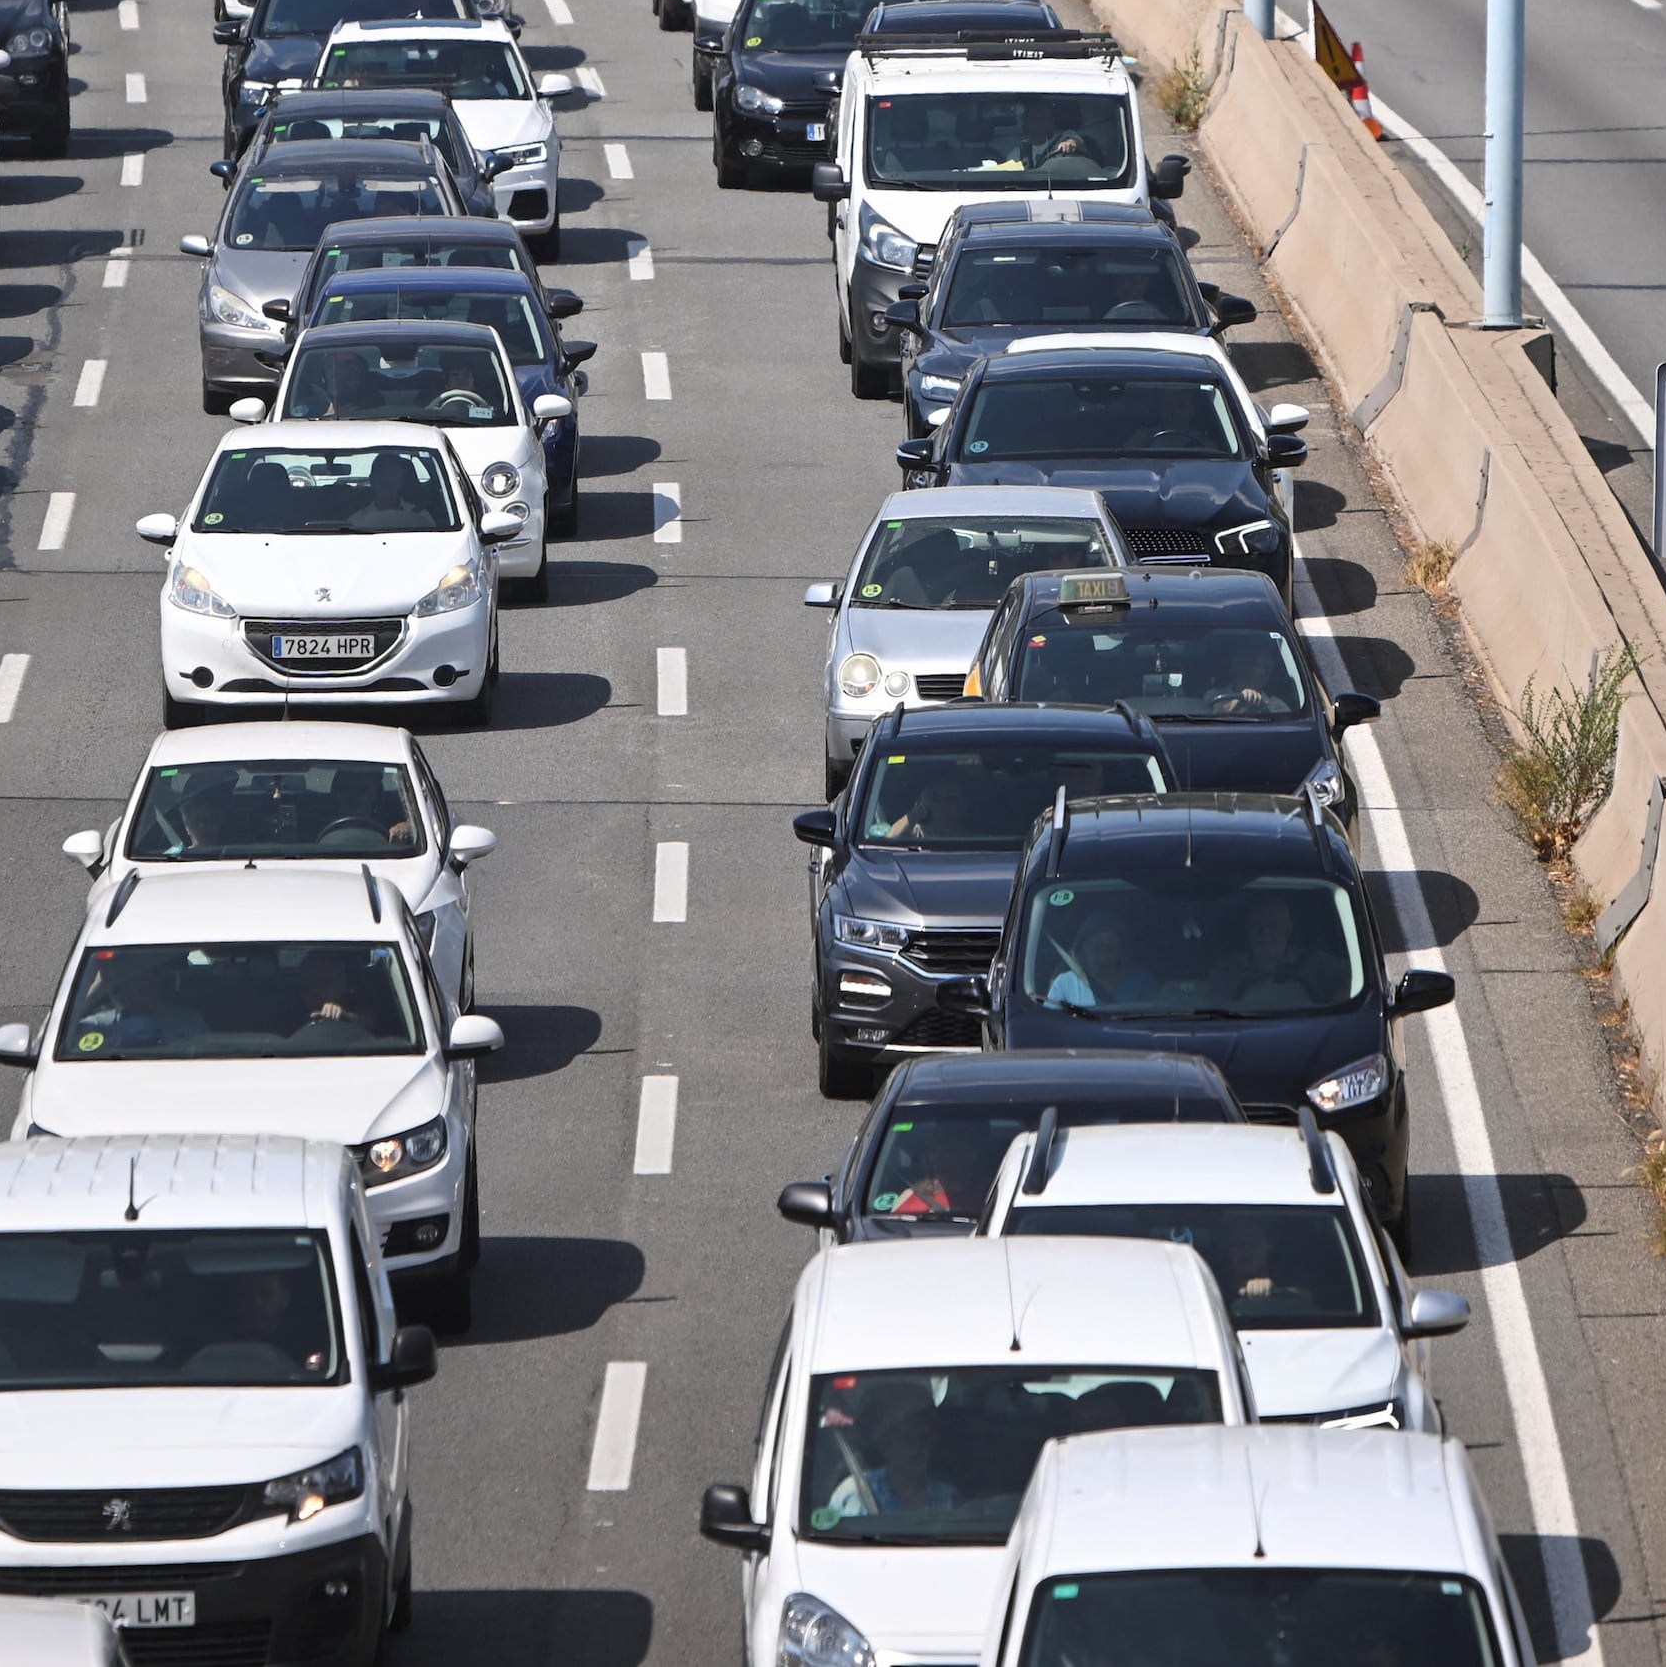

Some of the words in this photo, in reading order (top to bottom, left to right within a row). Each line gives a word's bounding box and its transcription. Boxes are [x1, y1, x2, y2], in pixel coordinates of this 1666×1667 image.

[1077, 580, 1106, 598] TAXI
[285, 639, 332, 655] 7824
[337, 638, 372, 655] HPR
[137, 1595, 187, 1624] LMT
